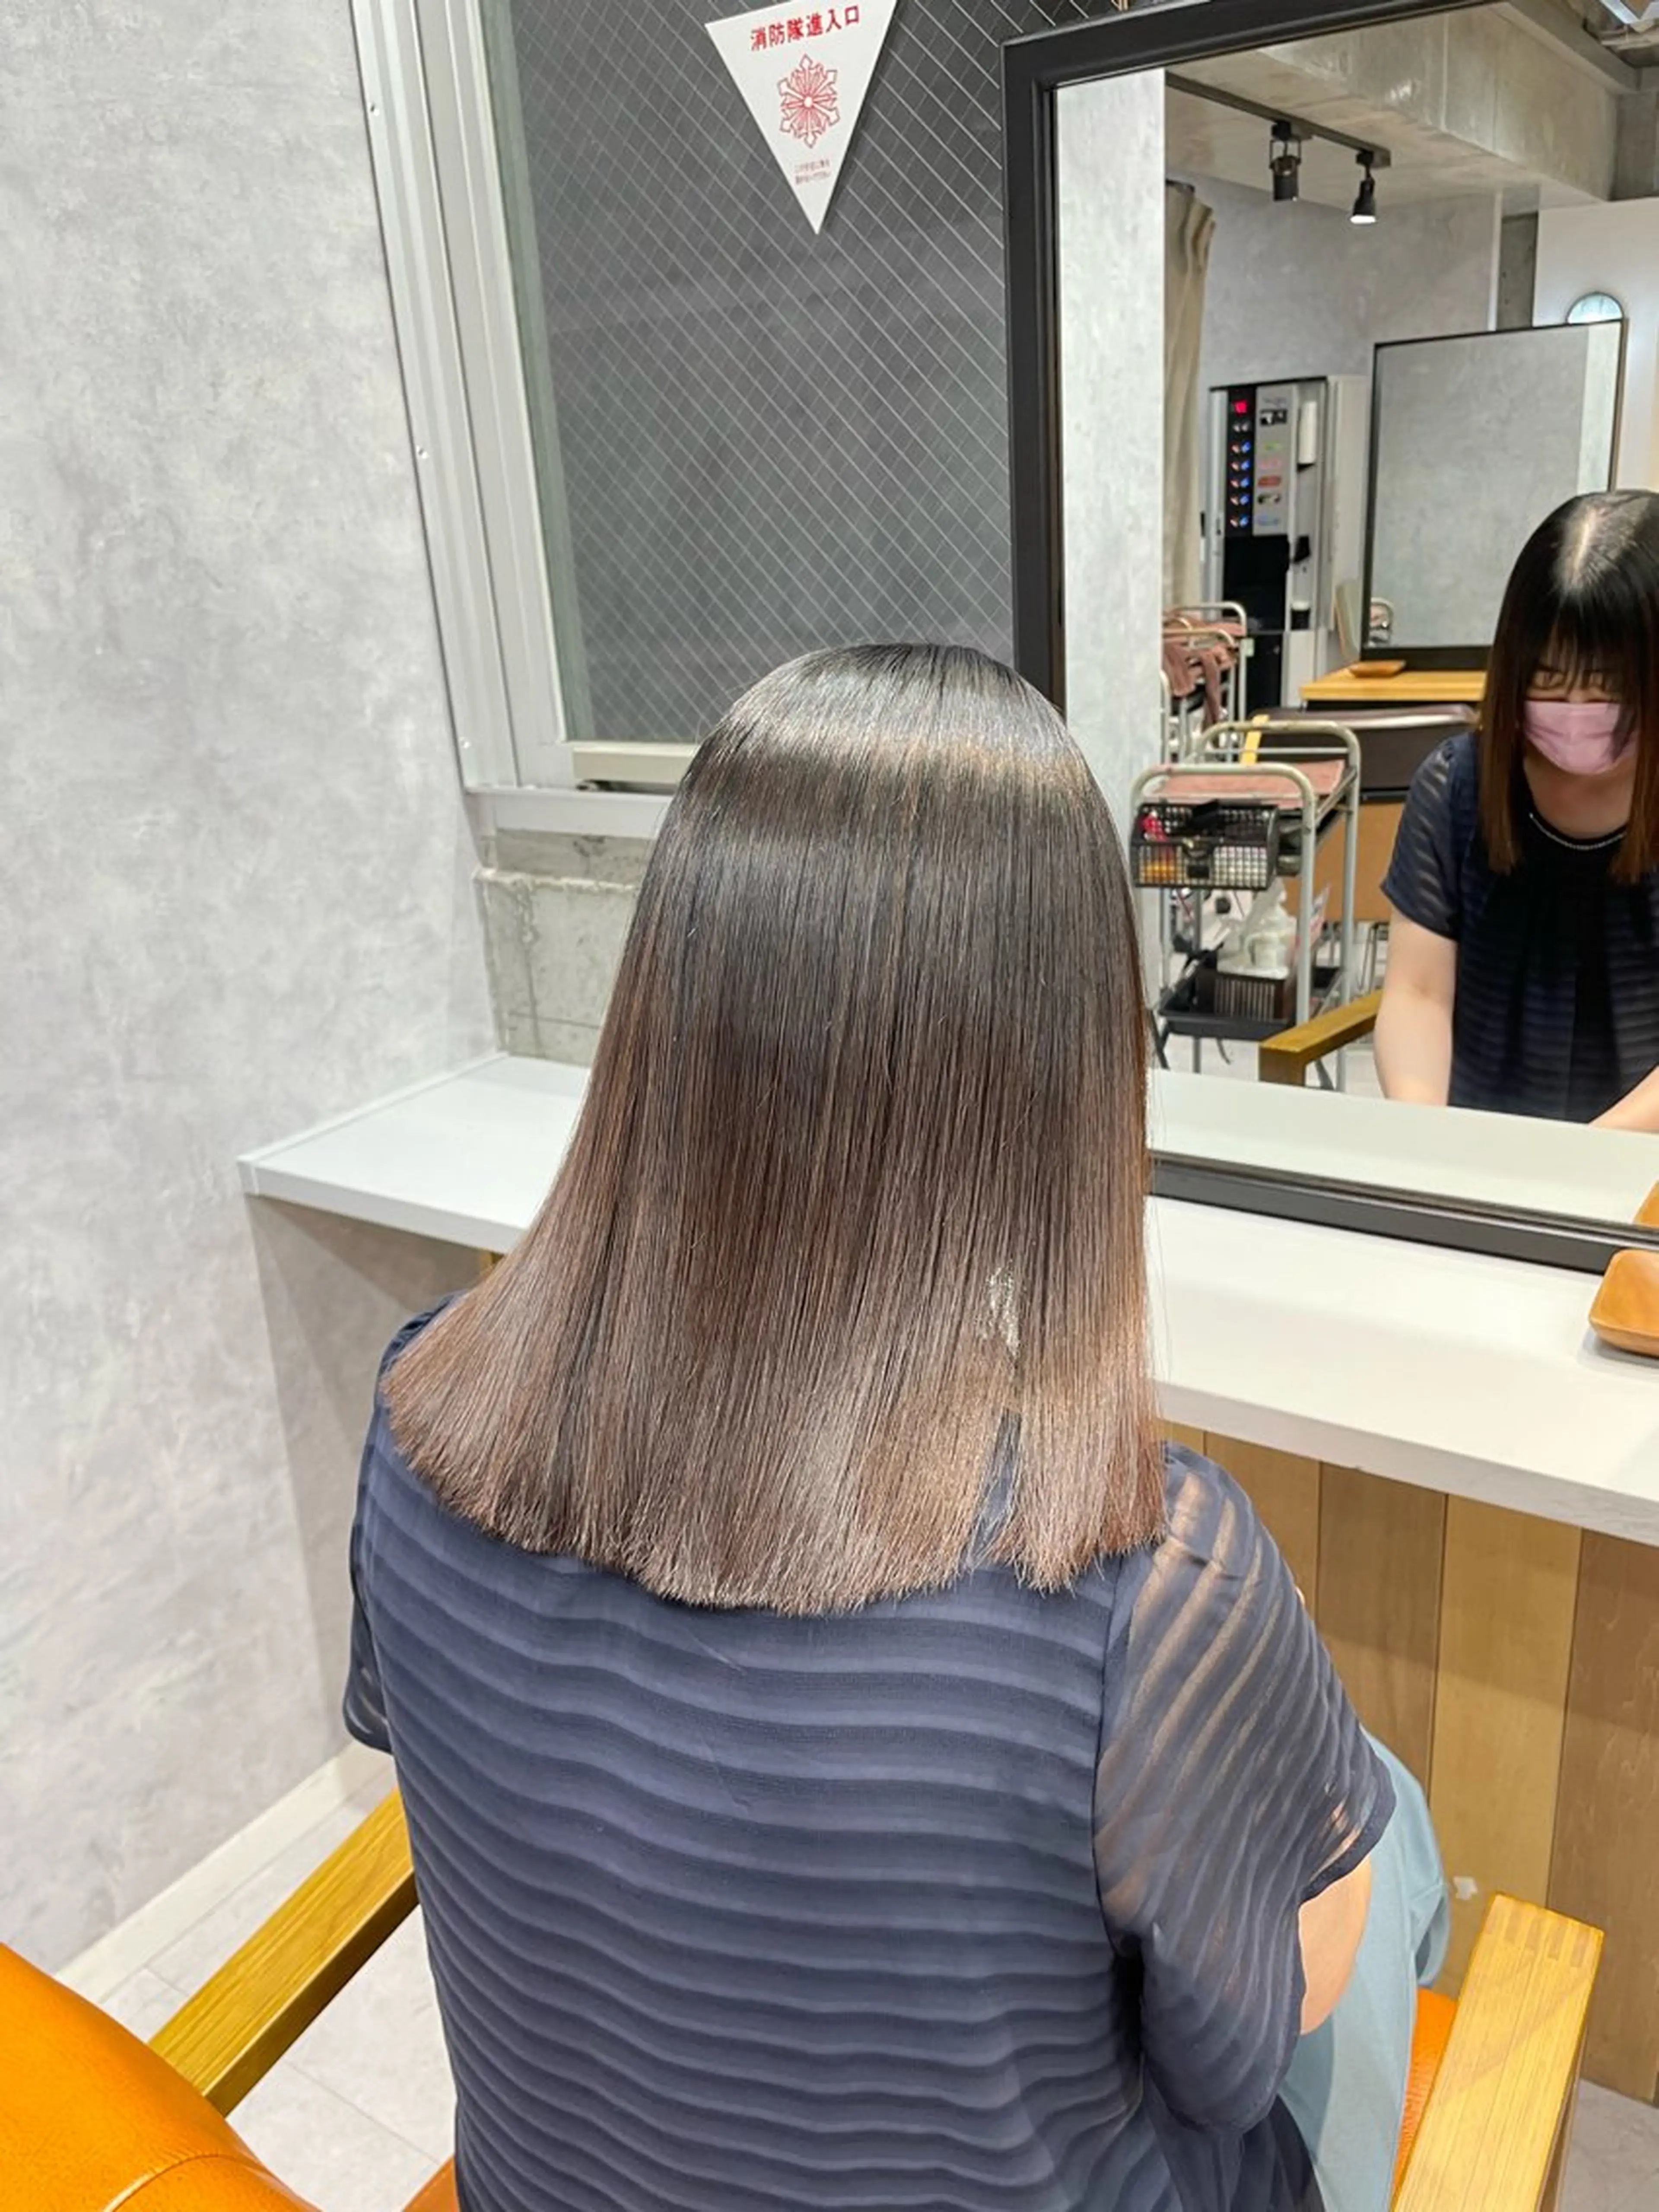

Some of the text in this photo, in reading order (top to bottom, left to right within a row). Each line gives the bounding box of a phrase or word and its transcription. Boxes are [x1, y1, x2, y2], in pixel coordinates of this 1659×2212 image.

[750, 5, 859, 51] 消防隊進入口
